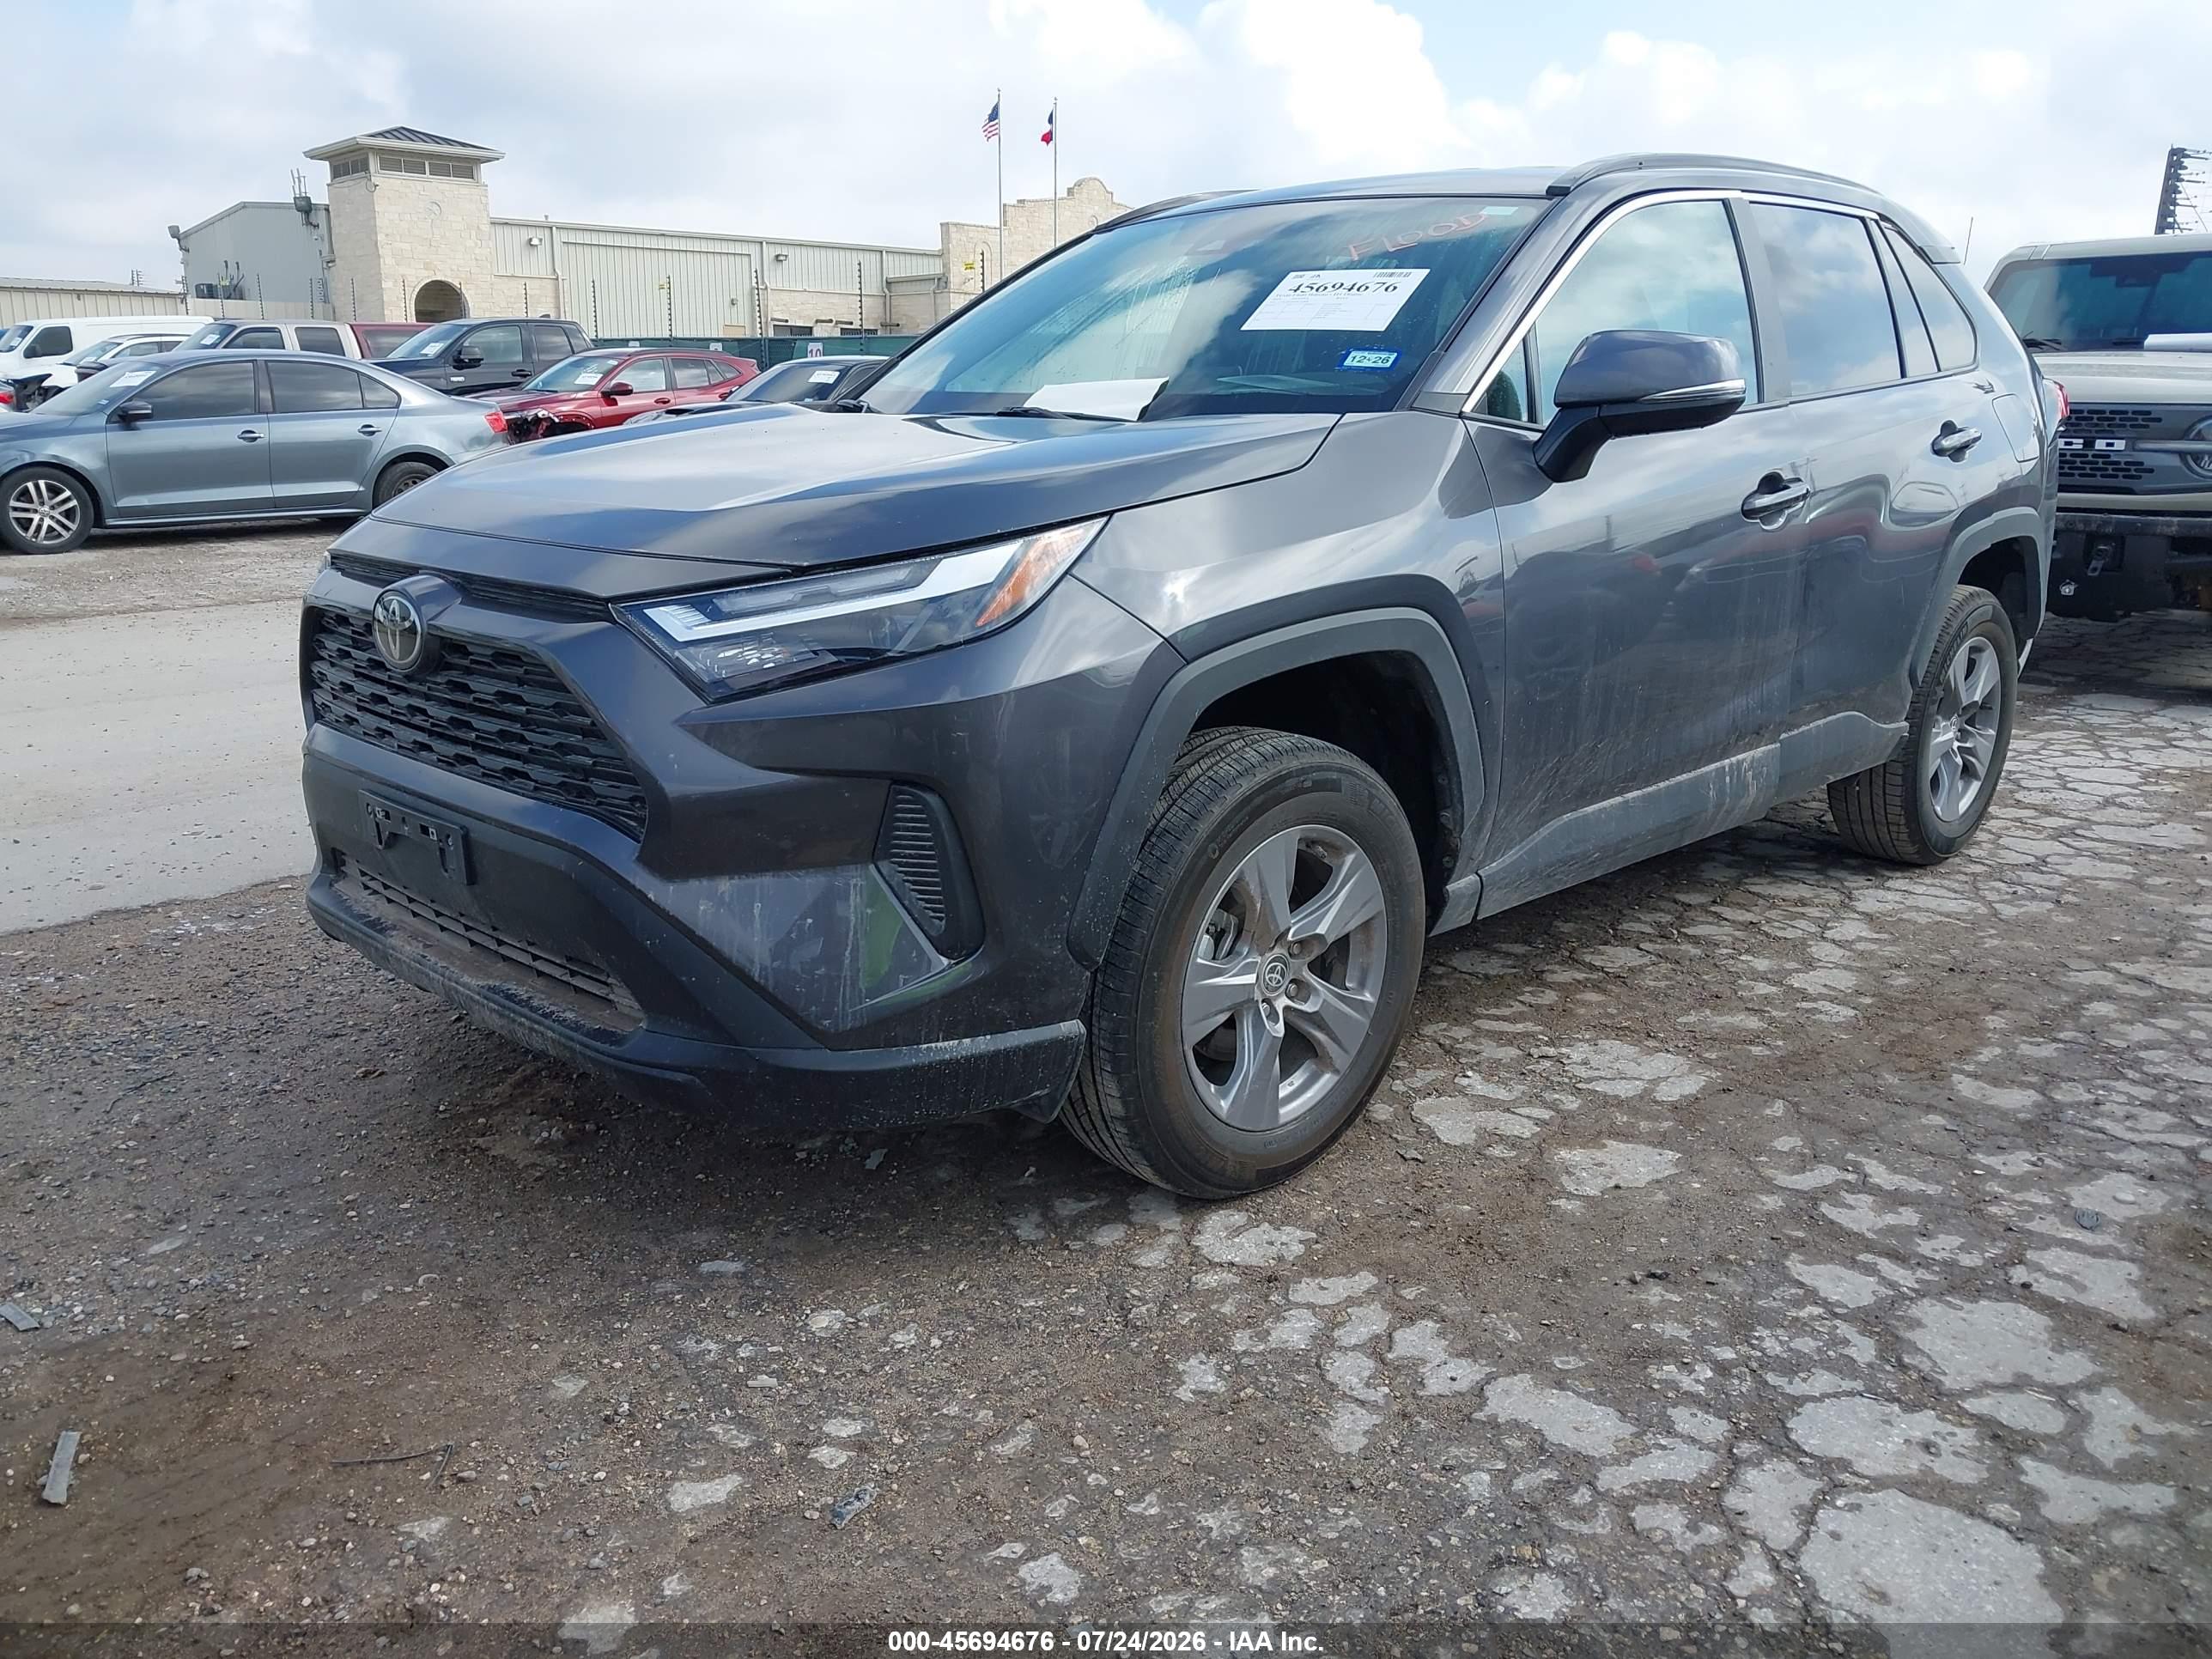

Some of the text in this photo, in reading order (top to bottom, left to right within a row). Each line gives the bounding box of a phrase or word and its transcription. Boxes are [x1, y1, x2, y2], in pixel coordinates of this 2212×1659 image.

[1347, 214, 1486, 261] FLOOD
[1288, 282, 1401, 294] 45694676
[1371, 356, 1391, 364] 26
